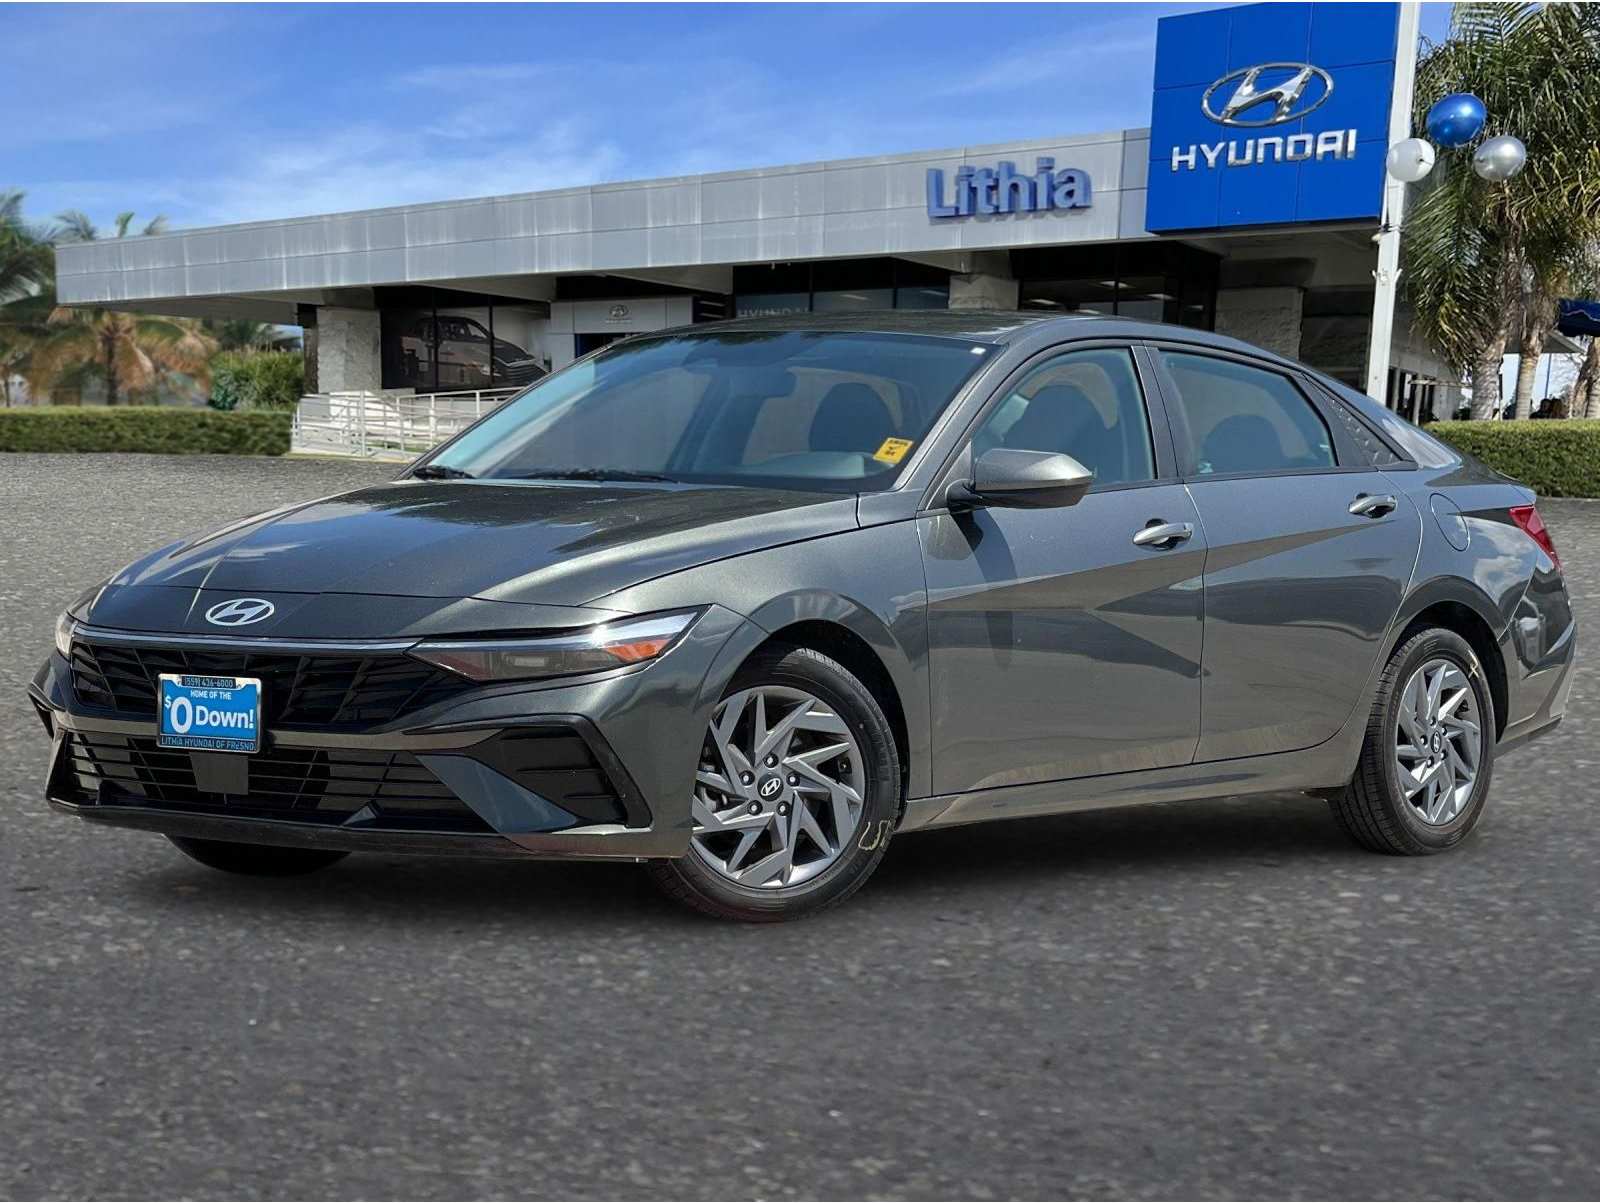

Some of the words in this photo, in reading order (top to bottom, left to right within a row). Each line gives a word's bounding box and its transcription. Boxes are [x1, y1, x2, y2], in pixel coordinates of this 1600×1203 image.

[1171, 129, 1357, 171] HYUNDAI
[926, 156, 1093, 218] Lithia
[190, 690, 208, 698] HOME
[209, 691, 218, 699] OF
[219, 692, 232, 700] THE
[195, 705, 254, 729] Down!
[184, 738, 215, 748] HYUNDAI
[216, 740, 225, 748] OF
